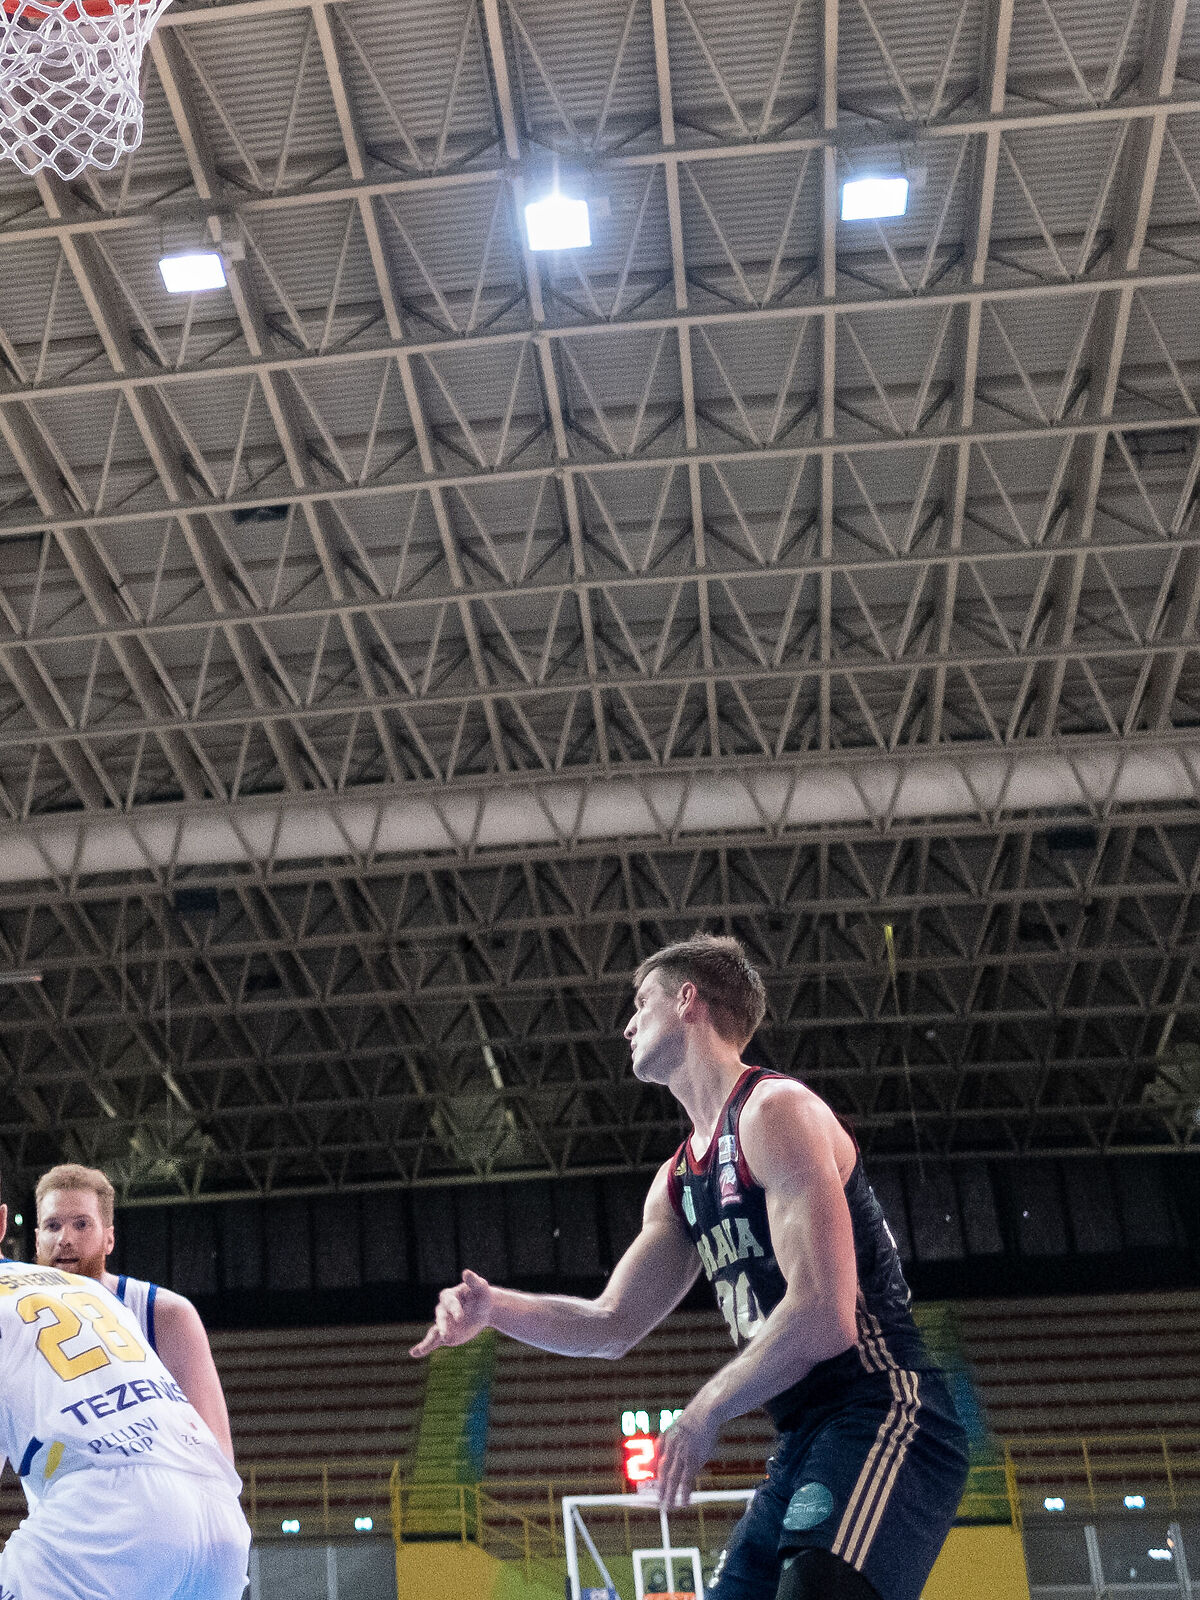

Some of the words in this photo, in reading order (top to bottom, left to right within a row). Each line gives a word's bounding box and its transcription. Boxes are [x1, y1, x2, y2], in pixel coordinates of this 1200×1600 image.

[16, 1291, 146, 1382] 28
[60, 1376, 190, 1426] TEZENIS
[87, 1417, 159, 1455] PELLINI
[116, 1436, 153, 1457] TOP
